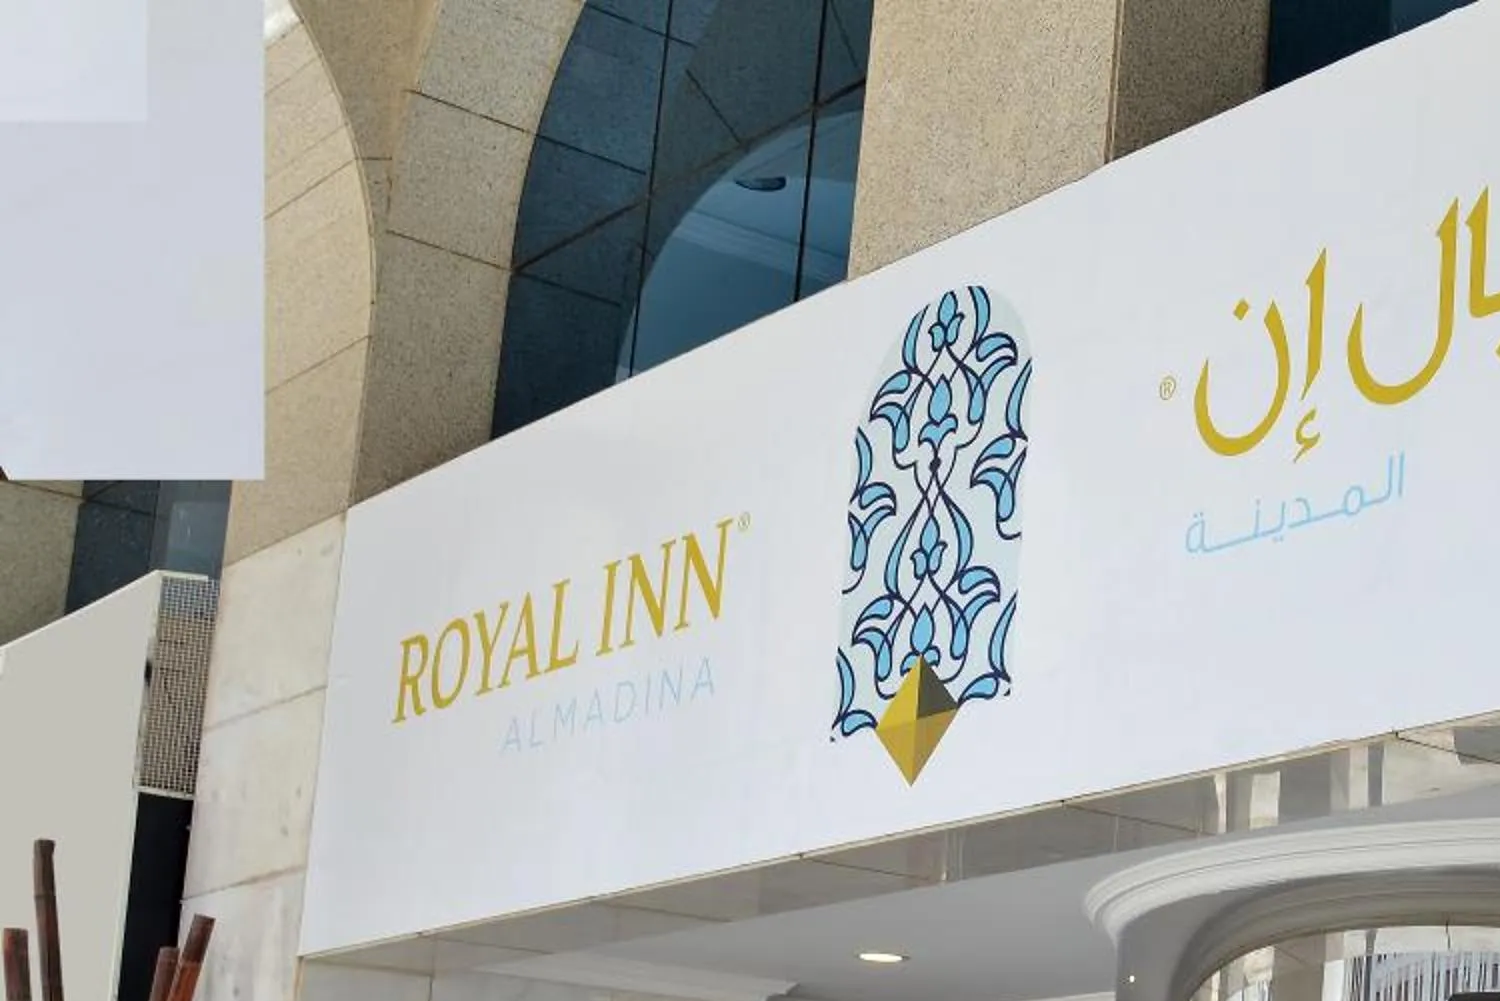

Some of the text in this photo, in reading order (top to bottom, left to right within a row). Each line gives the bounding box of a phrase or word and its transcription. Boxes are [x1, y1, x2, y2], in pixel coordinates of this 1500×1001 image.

[1193, 246, 1329, 463] إن
[1185, 451, 1405, 555] المدينة
[391, 517, 734, 724] ROYAL INN
[500, 655, 716, 753] ALMADINA
